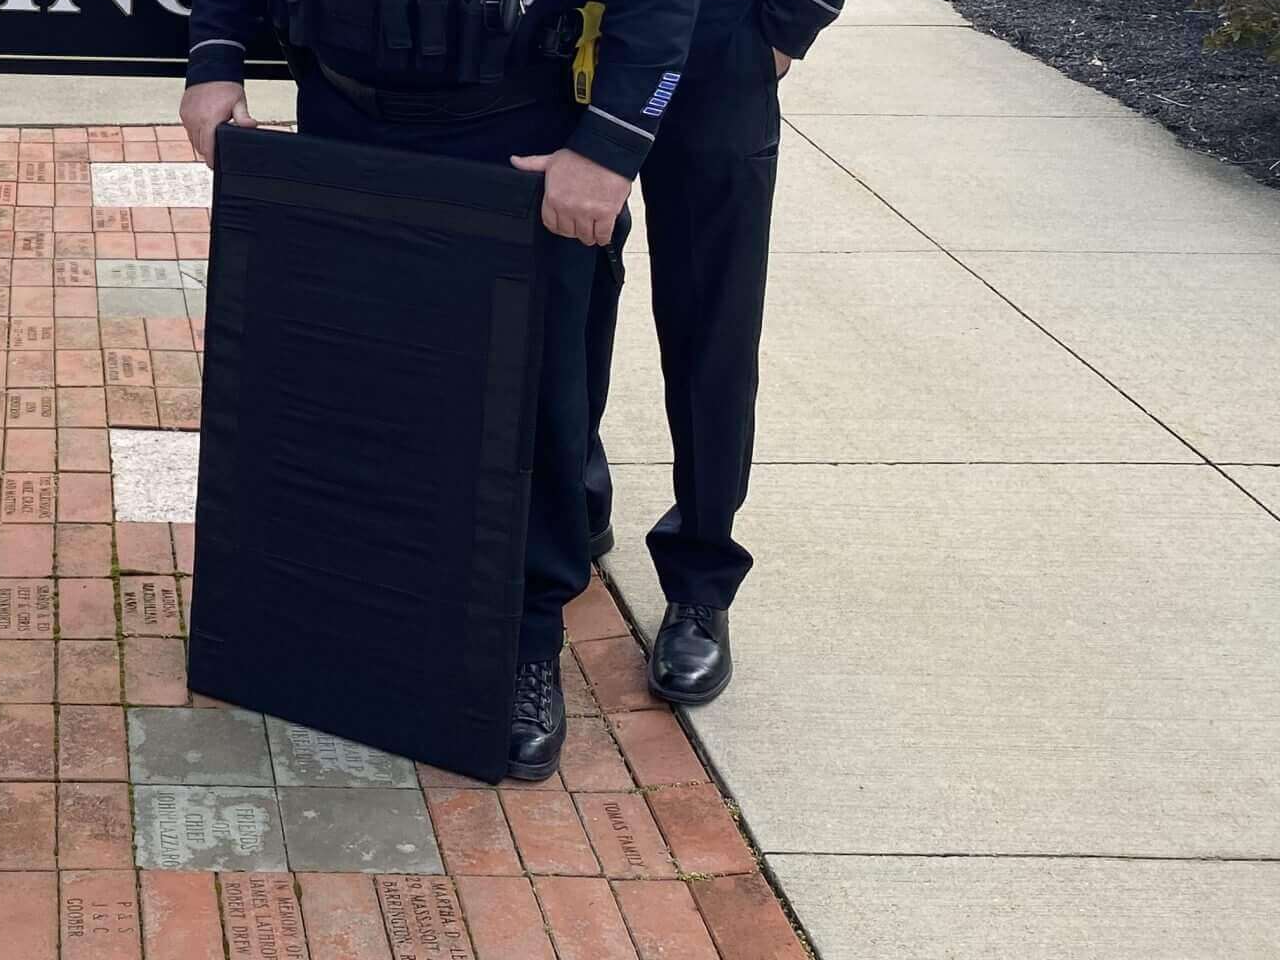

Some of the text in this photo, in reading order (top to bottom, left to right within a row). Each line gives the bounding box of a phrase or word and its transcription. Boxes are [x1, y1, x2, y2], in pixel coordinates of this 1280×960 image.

[17, 585, 31, 600] JEFF
[17, 611, 31, 632] CHRIS
[37, 622, 51, 632] ED
[184, 813, 205, 843] CHIEF
[211, 822, 231, 836] OF
[236, 807, 259, 851] FRIENDS
[604, 802, 649, 870] TOMAS FAMILY
[159, 820, 181, 868] LAZZARO
[249, 878, 270, 909] JAMES
[66, 898, 85, 938] GOOBER
[93, 912, 109, 921] &
[117, 912, 133, 921] &
[225, 882, 252, 956] ROBERT DREW
[273, 879, 304, 959] IN MEMORY OF
[405, 877, 441, 952] 29 MASSASOIT
